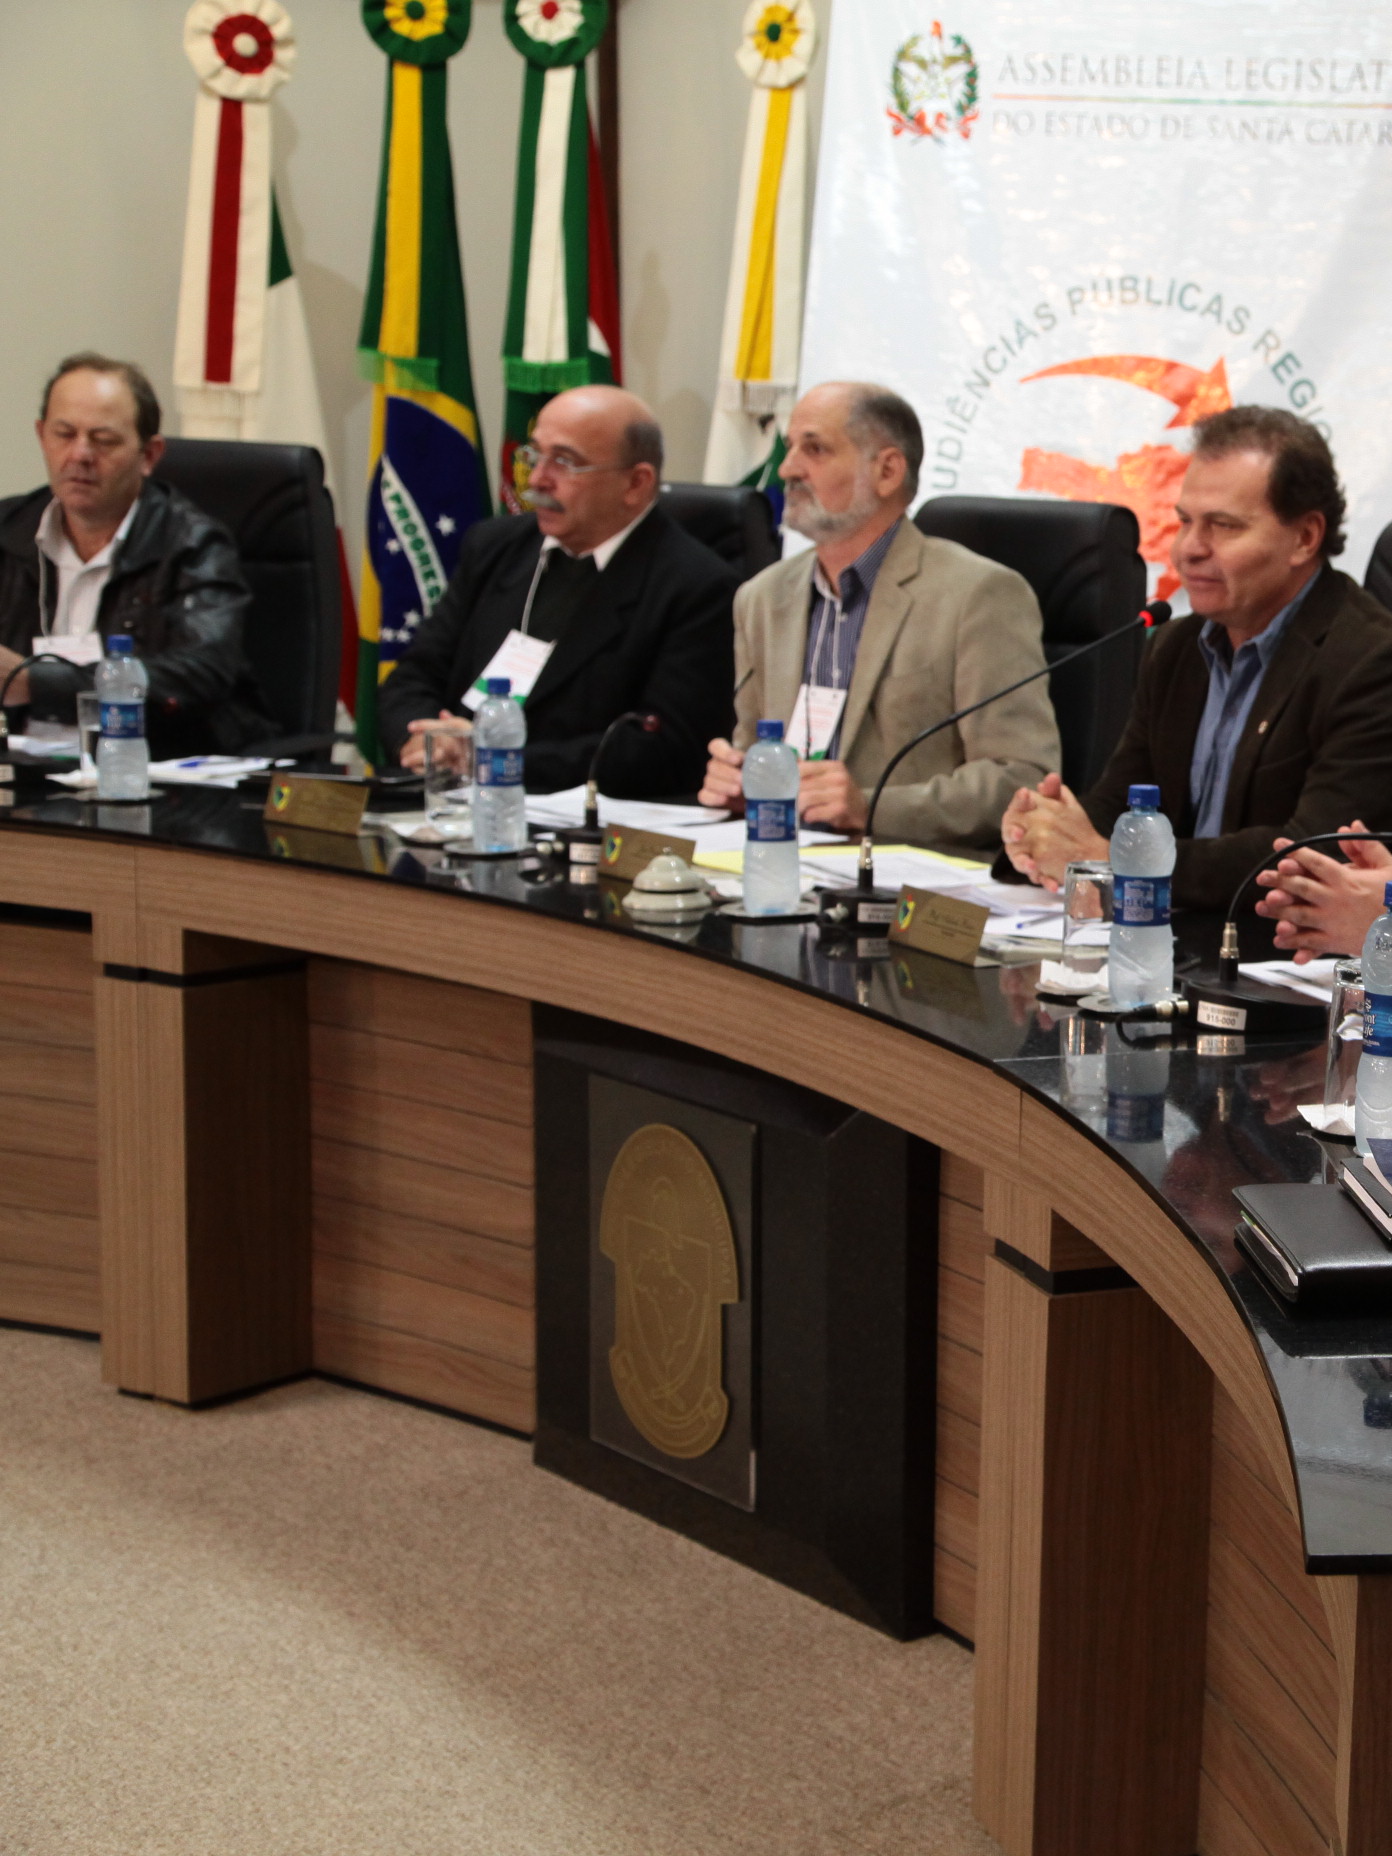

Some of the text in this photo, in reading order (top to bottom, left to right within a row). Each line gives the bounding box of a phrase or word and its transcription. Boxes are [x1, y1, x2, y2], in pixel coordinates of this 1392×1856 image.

[998, 53, 1211, 90] ASSEMBLEIA
[992, 109, 1036, 138] DO
[1045, 109, 1150, 141] ESTADO
[1160, 113, 1194, 142] DE
[1206, 114, 1295, 144] SANTA
[931, 302, 1057, 490] UDIÊNCIAS
[1253, 329, 1333, 444] REGIO
